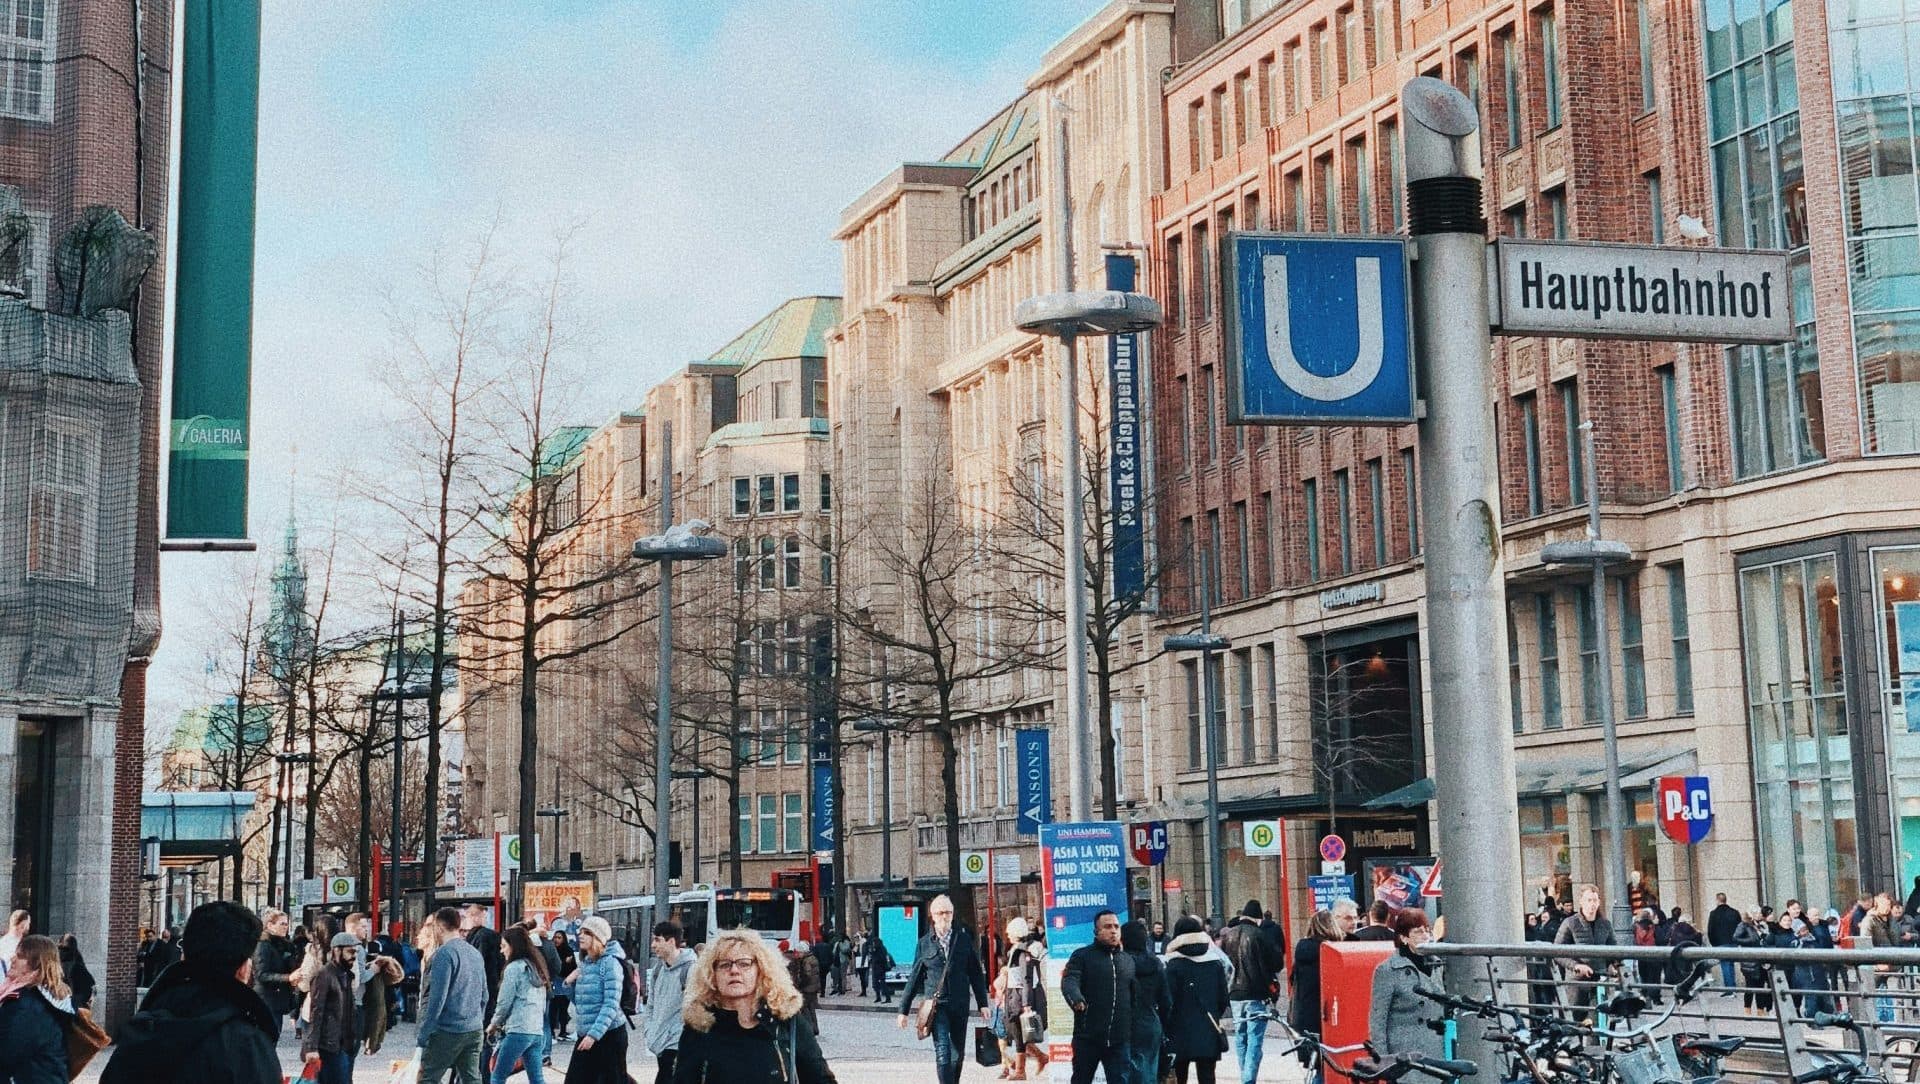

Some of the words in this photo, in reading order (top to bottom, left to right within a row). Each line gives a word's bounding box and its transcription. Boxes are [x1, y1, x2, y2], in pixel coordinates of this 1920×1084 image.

[1521, 260, 1773, 320] Hauptbahnhof
[1263, 254, 1384, 401] U
[190, 428, 243, 444] GALERIA
[1114, 334, 1136, 527] Peek&Cloppenbur
[1024, 741, 1043, 823] ANSON'S
[819, 776, 834, 842] ANSON'S
[1665, 789, 1709, 821] P&C
[1080, 845, 1094, 858] LA
[1095, 844, 1120, 857] VISTA
[1135, 828, 1165, 850] P&C
[1054, 862, 1077, 875] UND
[1080, 858, 1119, 874] TSCHÜSS
[1055, 878, 1083, 891] FREIE
